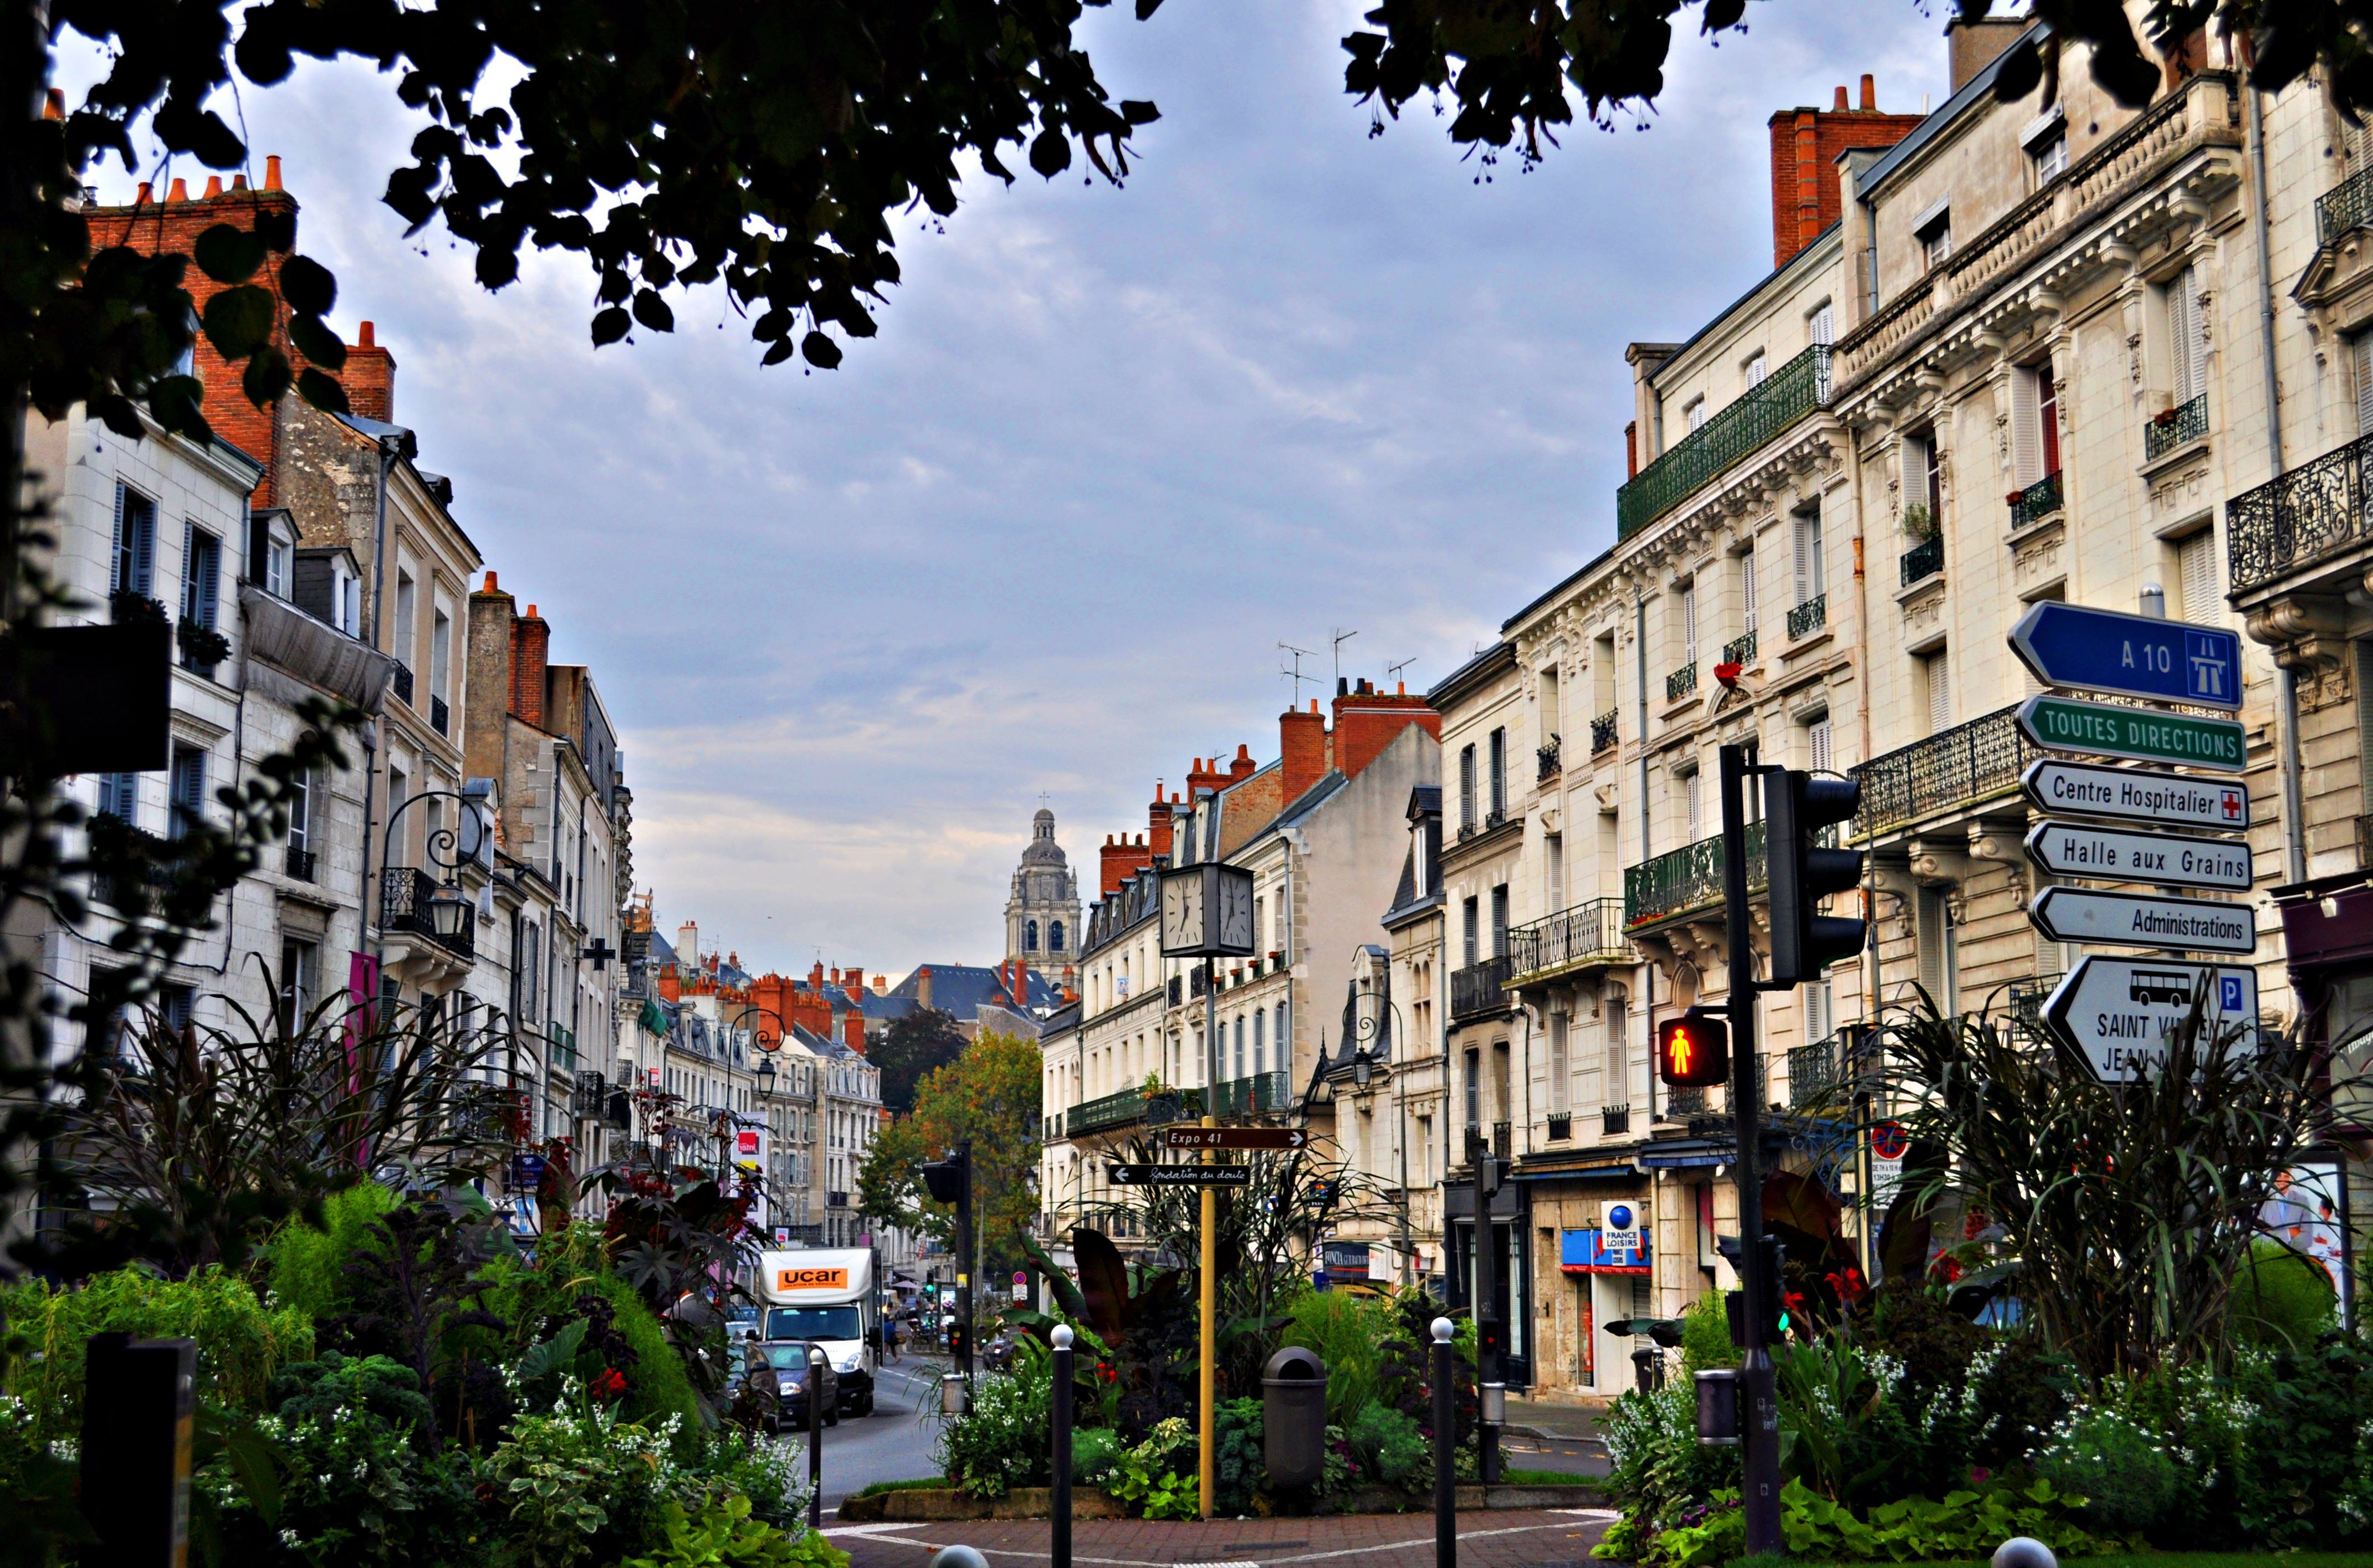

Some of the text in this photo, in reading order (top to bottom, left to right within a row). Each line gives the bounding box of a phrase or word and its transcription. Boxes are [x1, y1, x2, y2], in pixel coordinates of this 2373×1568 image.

[2121, 640, 2171, 673] A 10
[2045, 710, 2237, 759] TOUTES DIRECTIONS
[2053, 775, 2215, 817] Centre Hospitalier
[2064, 838, 2244, 878] Halle aux Grains
[2132, 909, 2243, 940] Administrations
[2225, 981, 2236, 1007] P
[2096, 1013, 2149, 1039] SAINT
[2102, 1048, 2148, 1072] JEAN
[1170, 1133, 1222, 1145] Expo 41
[1200, 1171, 1214, 1179] du
[1217, 1170, 1245, 1180] doute
[1324, 1251, 1343, 1265] FONCIA
[784, 1270, 841, 1284] ucar
